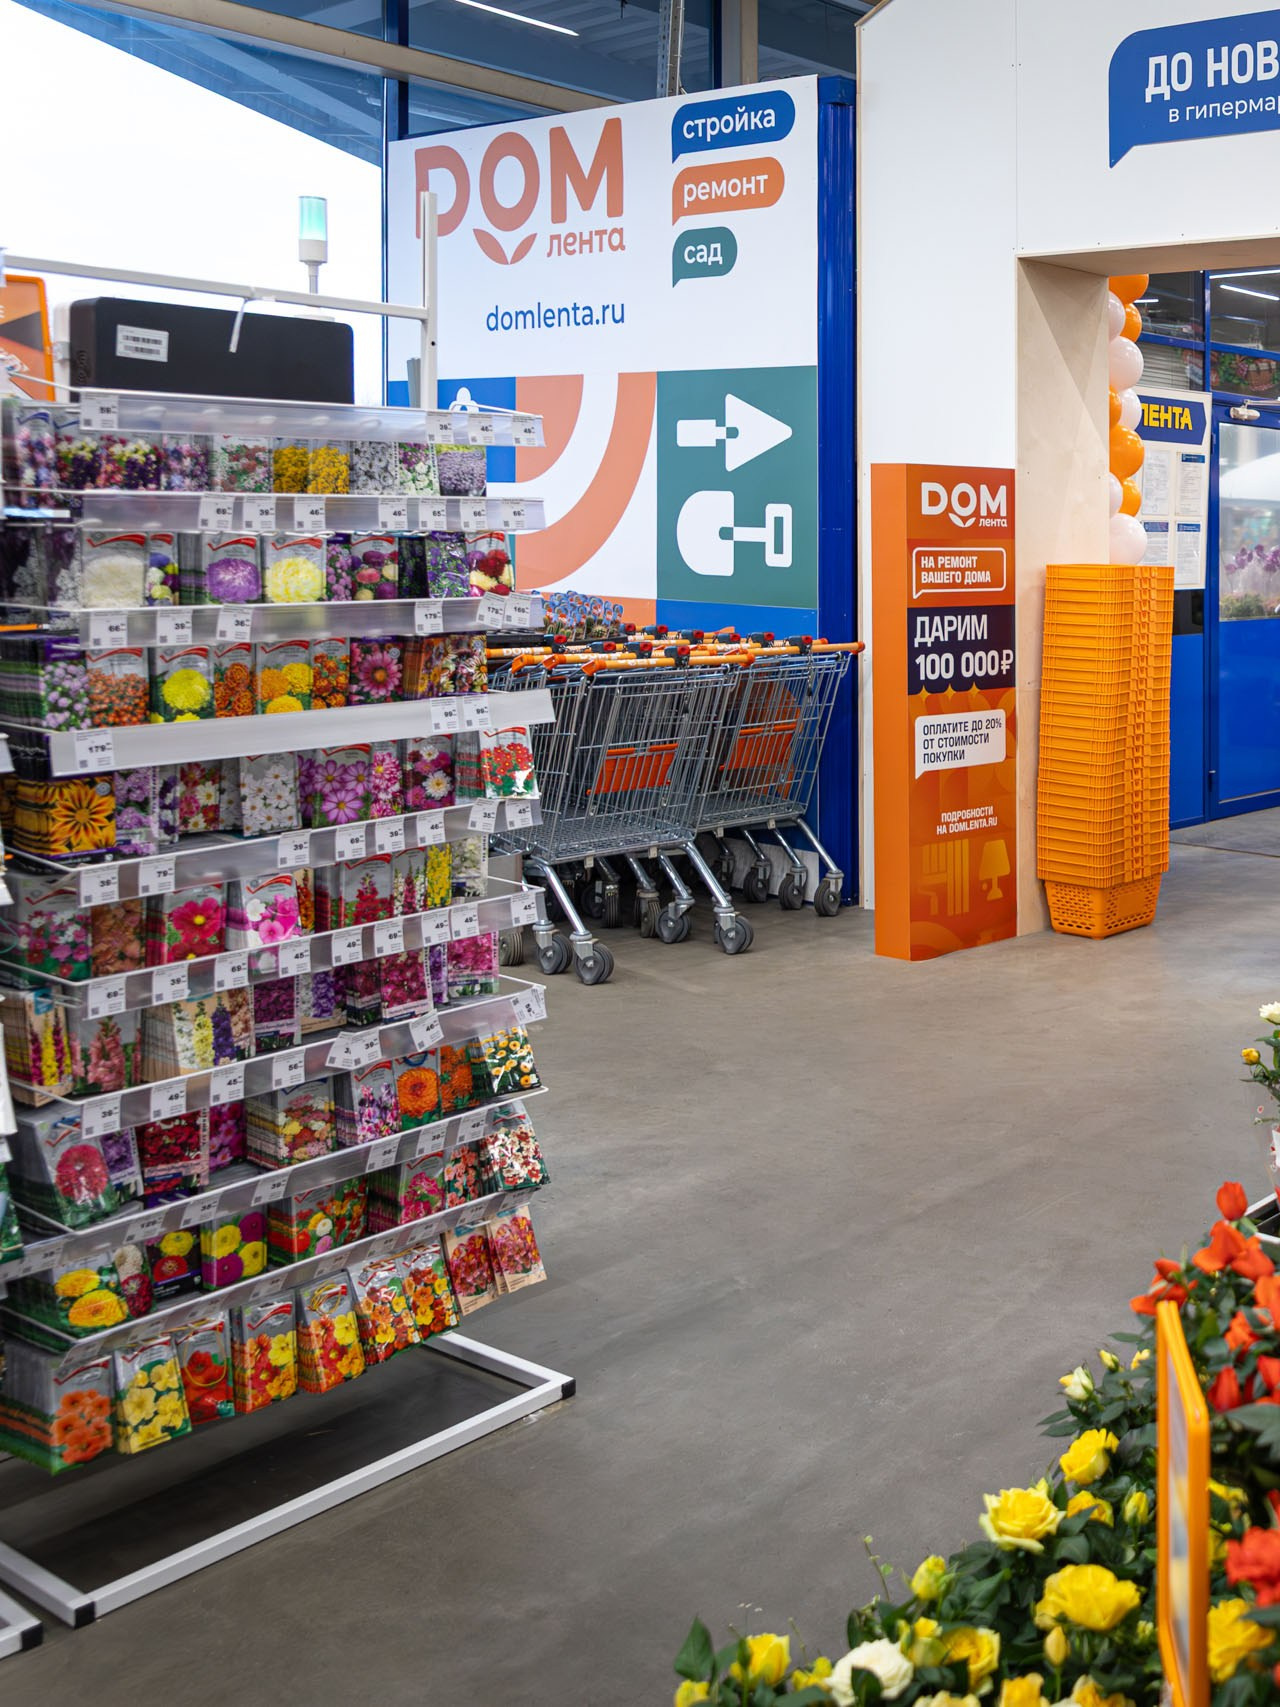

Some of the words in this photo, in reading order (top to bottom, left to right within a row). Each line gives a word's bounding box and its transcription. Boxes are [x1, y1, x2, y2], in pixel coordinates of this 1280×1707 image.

[1145, 51, 1193, 103] ДО
[683, 105, 776, 142] стройка
[1168, 108, 1180, 123] в
[683, 173, 768, 208] ремонт
[546, 226, 626, 258] лента
[683, 243, 723, 267] сад
[486, 301, 625, 332] domlenta.ru
[979, 517, 1008, 527] лента
[921, 556, 935, 569] НА
[938, 556, 978, 569] РЕМОНТ
[921, 571, 962, 584] ВАШЕГО
[964, 570, 991, 585] ДОМА
[914, 614, 988, 648] ДАРИМ
[915, 652, 955, 681] 100
[923, 721, 969, 736] ОПЛАТИТЕ
[971, 719, 983, 733] ДО
[985, 717, 1002, 730] 20%
[923, 738, 934, 750] ОТ
[938, 733, 990, 749] СТОИМОСТИ
[923, 749, 965, 764] ПОКУПКИ
[941, 806, 994, 823] ПОДРОБНОСТИ
[937, 824, 947, 835] НА
[949, 817, 998, 834] DOMLENTA.RU
